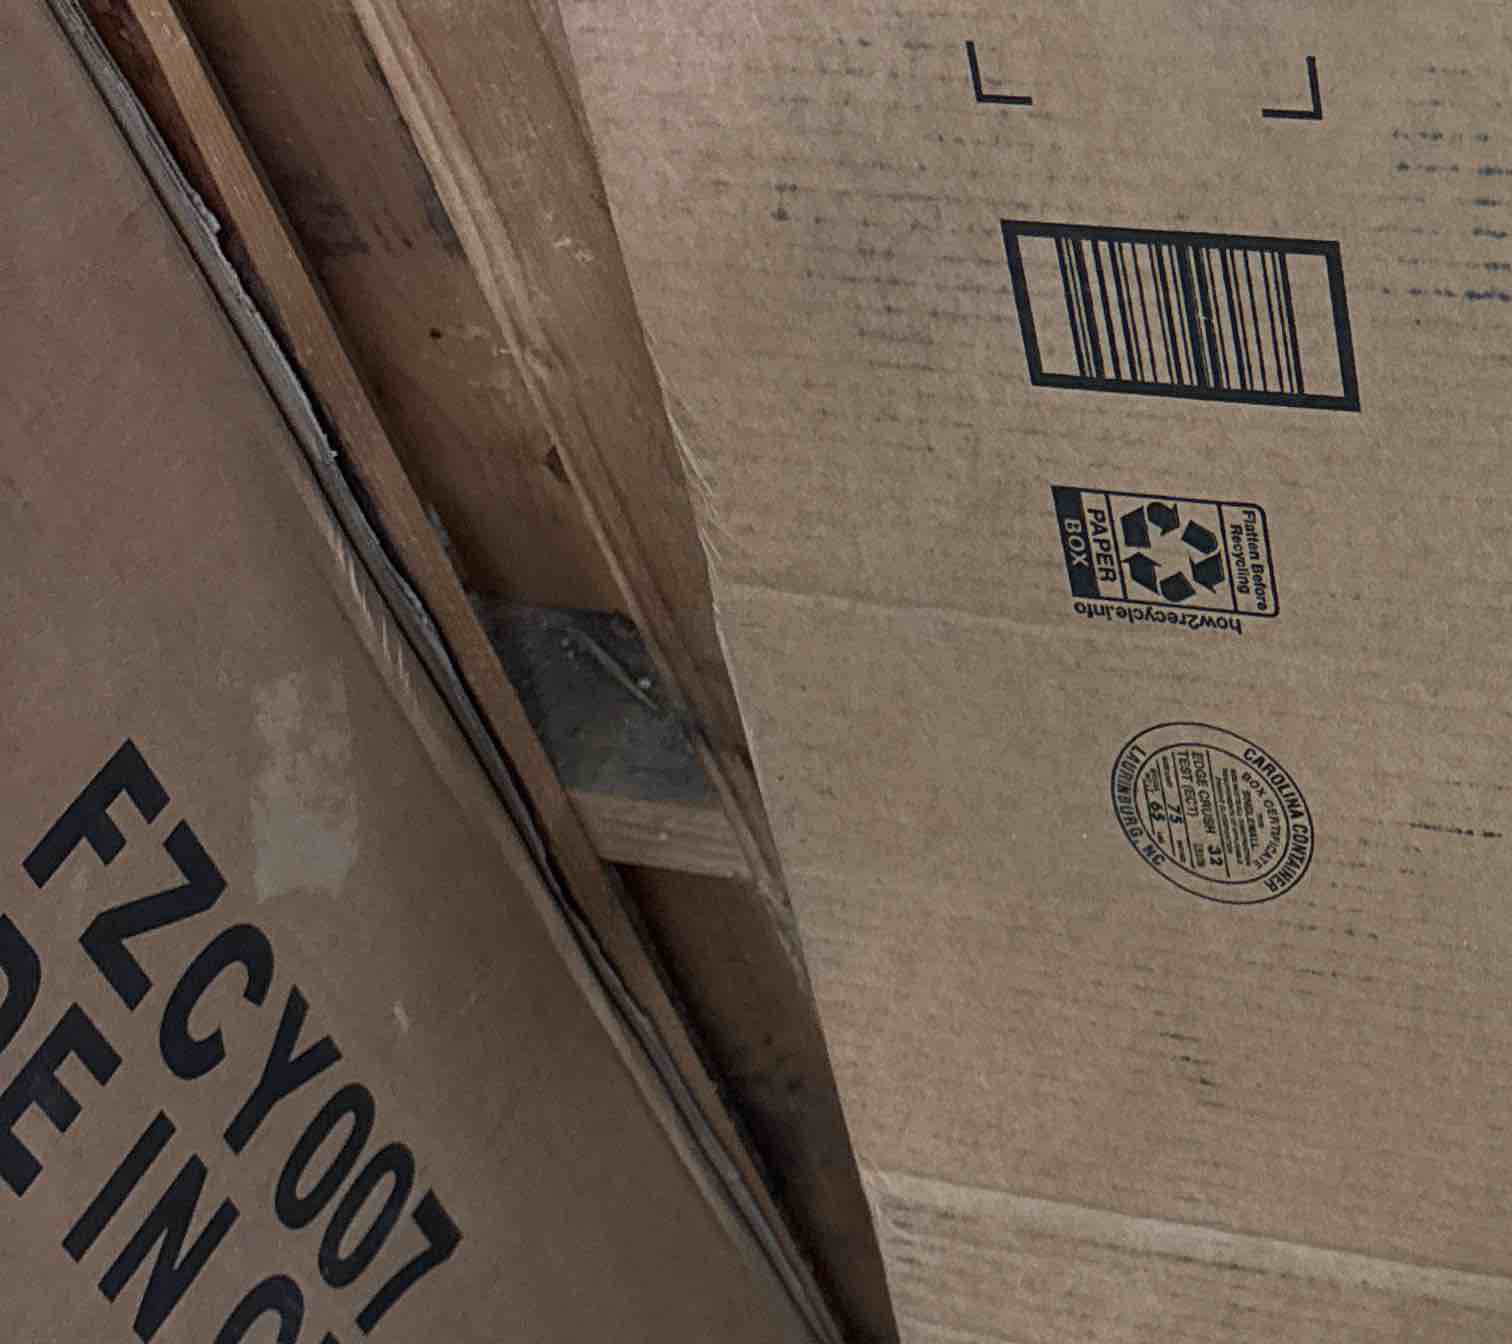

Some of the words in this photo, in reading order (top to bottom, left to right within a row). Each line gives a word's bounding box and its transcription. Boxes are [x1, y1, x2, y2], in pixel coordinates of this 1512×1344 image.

[1063, 517, 1088, 566] BOX
[1087, 508, 1116, 584] PAPER
[1242, 509, 1259, 559] Flatten
[1230, 524, 1250, 594] Recycling
[1250, 563, 1267, 611] Before
[1073, 601, 1243, 634] how2recycle.info
[1177, 750, 1193, 783] TEST
[1191, 750, 1209, 788] EDGE
[1241, 771, 1266, 796] BOX
[1244, 747, 1304, 819] CAROLINA
[1149, 801, 1165, 822] 65
[1167, 804, 1184, 825] 75
[1182, 785, 1199, 817] (ECT)
[1198, 789, 1216, 834] CRUSH
[1142, 843, 1166, 865] NC
[1207, 844, 1223, 866] 32
[1253, 799, 1281, 870] CERTIFICATE
[1264, 822, 1309, 893] CONTAINER
[22, 737, 463, 1336] FZCY007
[62, 1110, 240, 1344] IN
